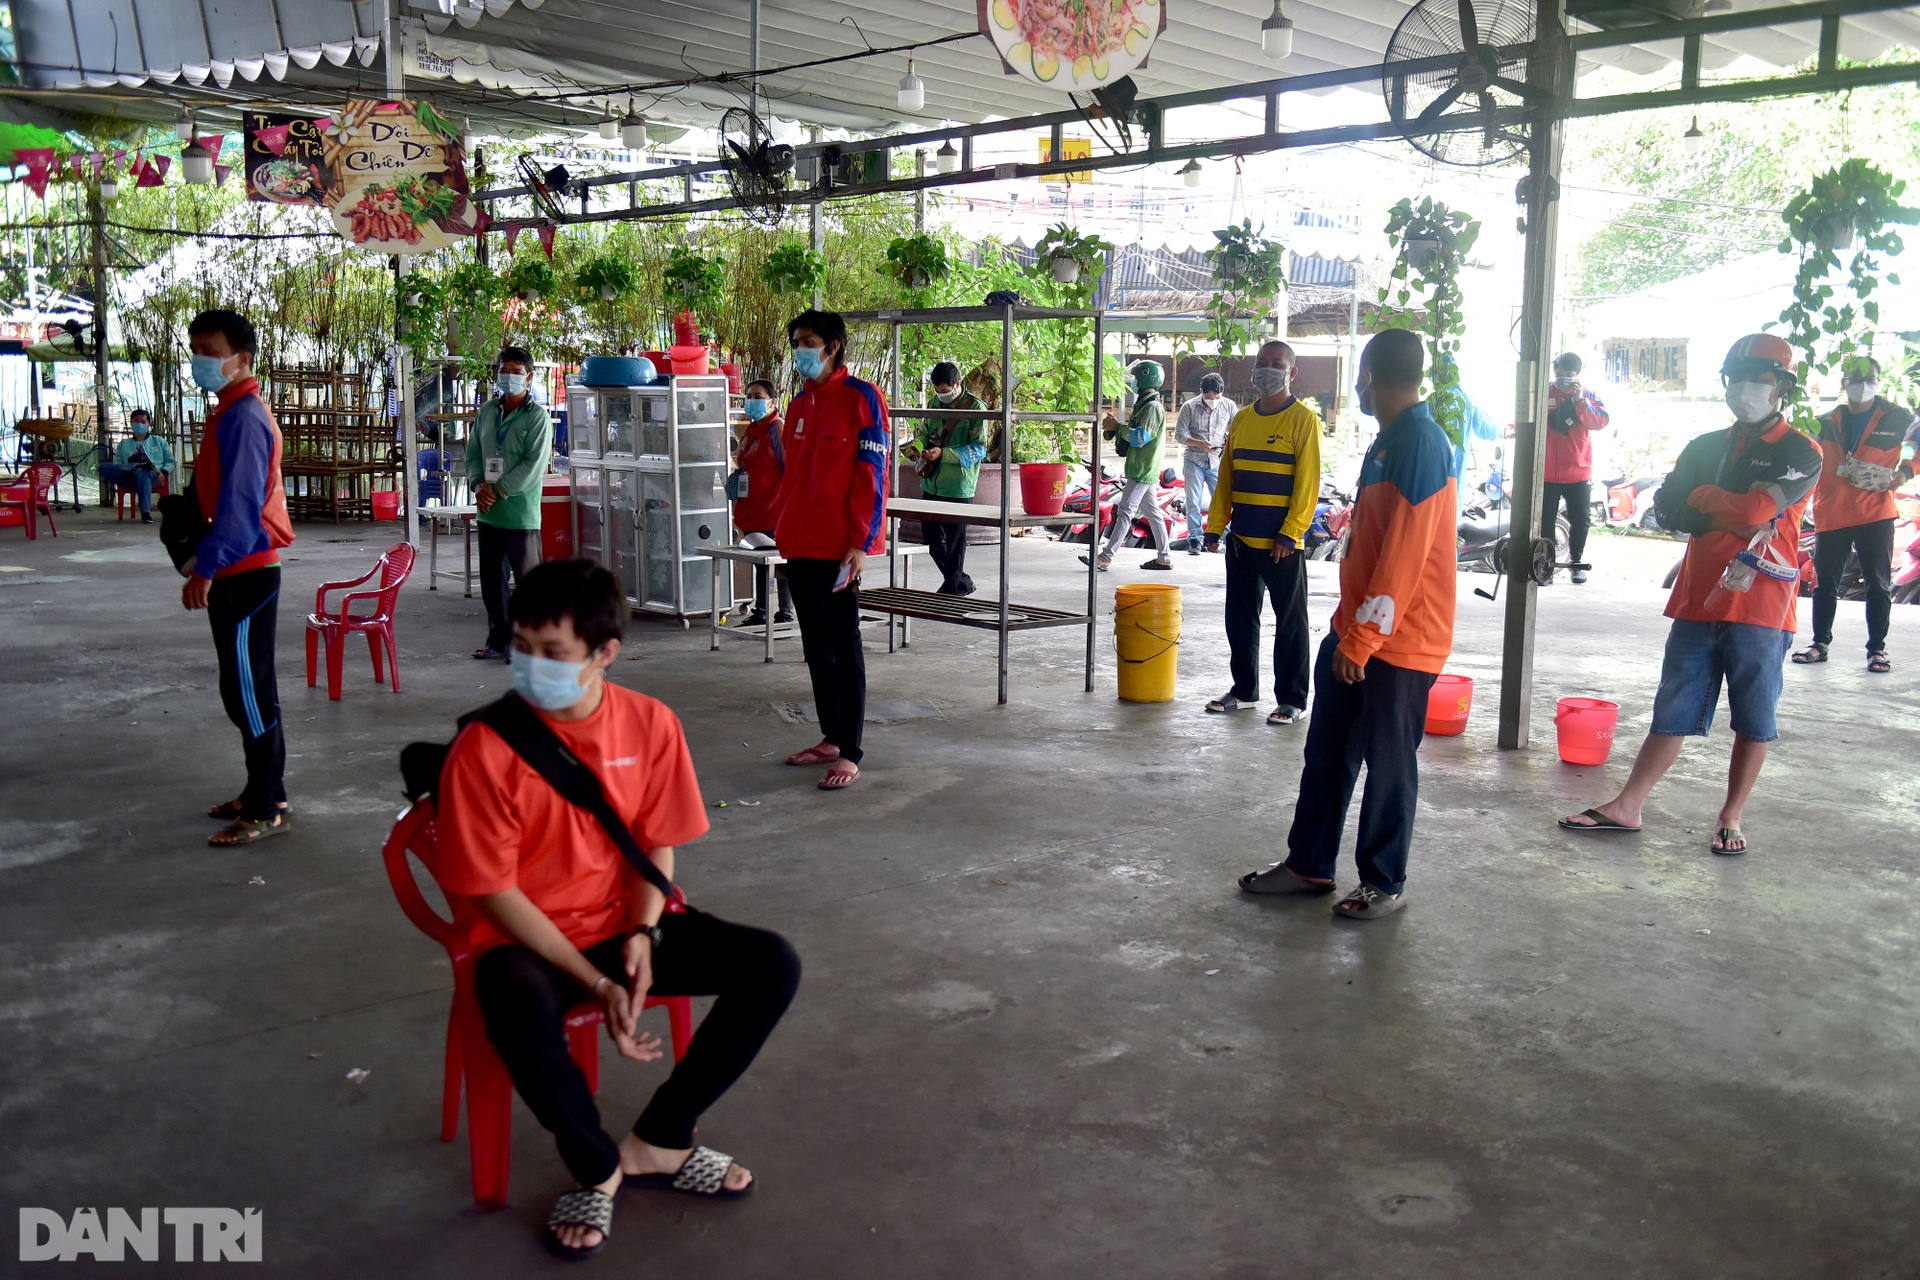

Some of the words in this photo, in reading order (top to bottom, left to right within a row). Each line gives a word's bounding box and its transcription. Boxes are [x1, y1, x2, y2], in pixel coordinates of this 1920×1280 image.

[368, 121, 410, 141] Dồi
[346, 151, 406, 171] Chiên
[399, 141, 434, 161] Dê
[1664, 346, 1679, 380] XE
